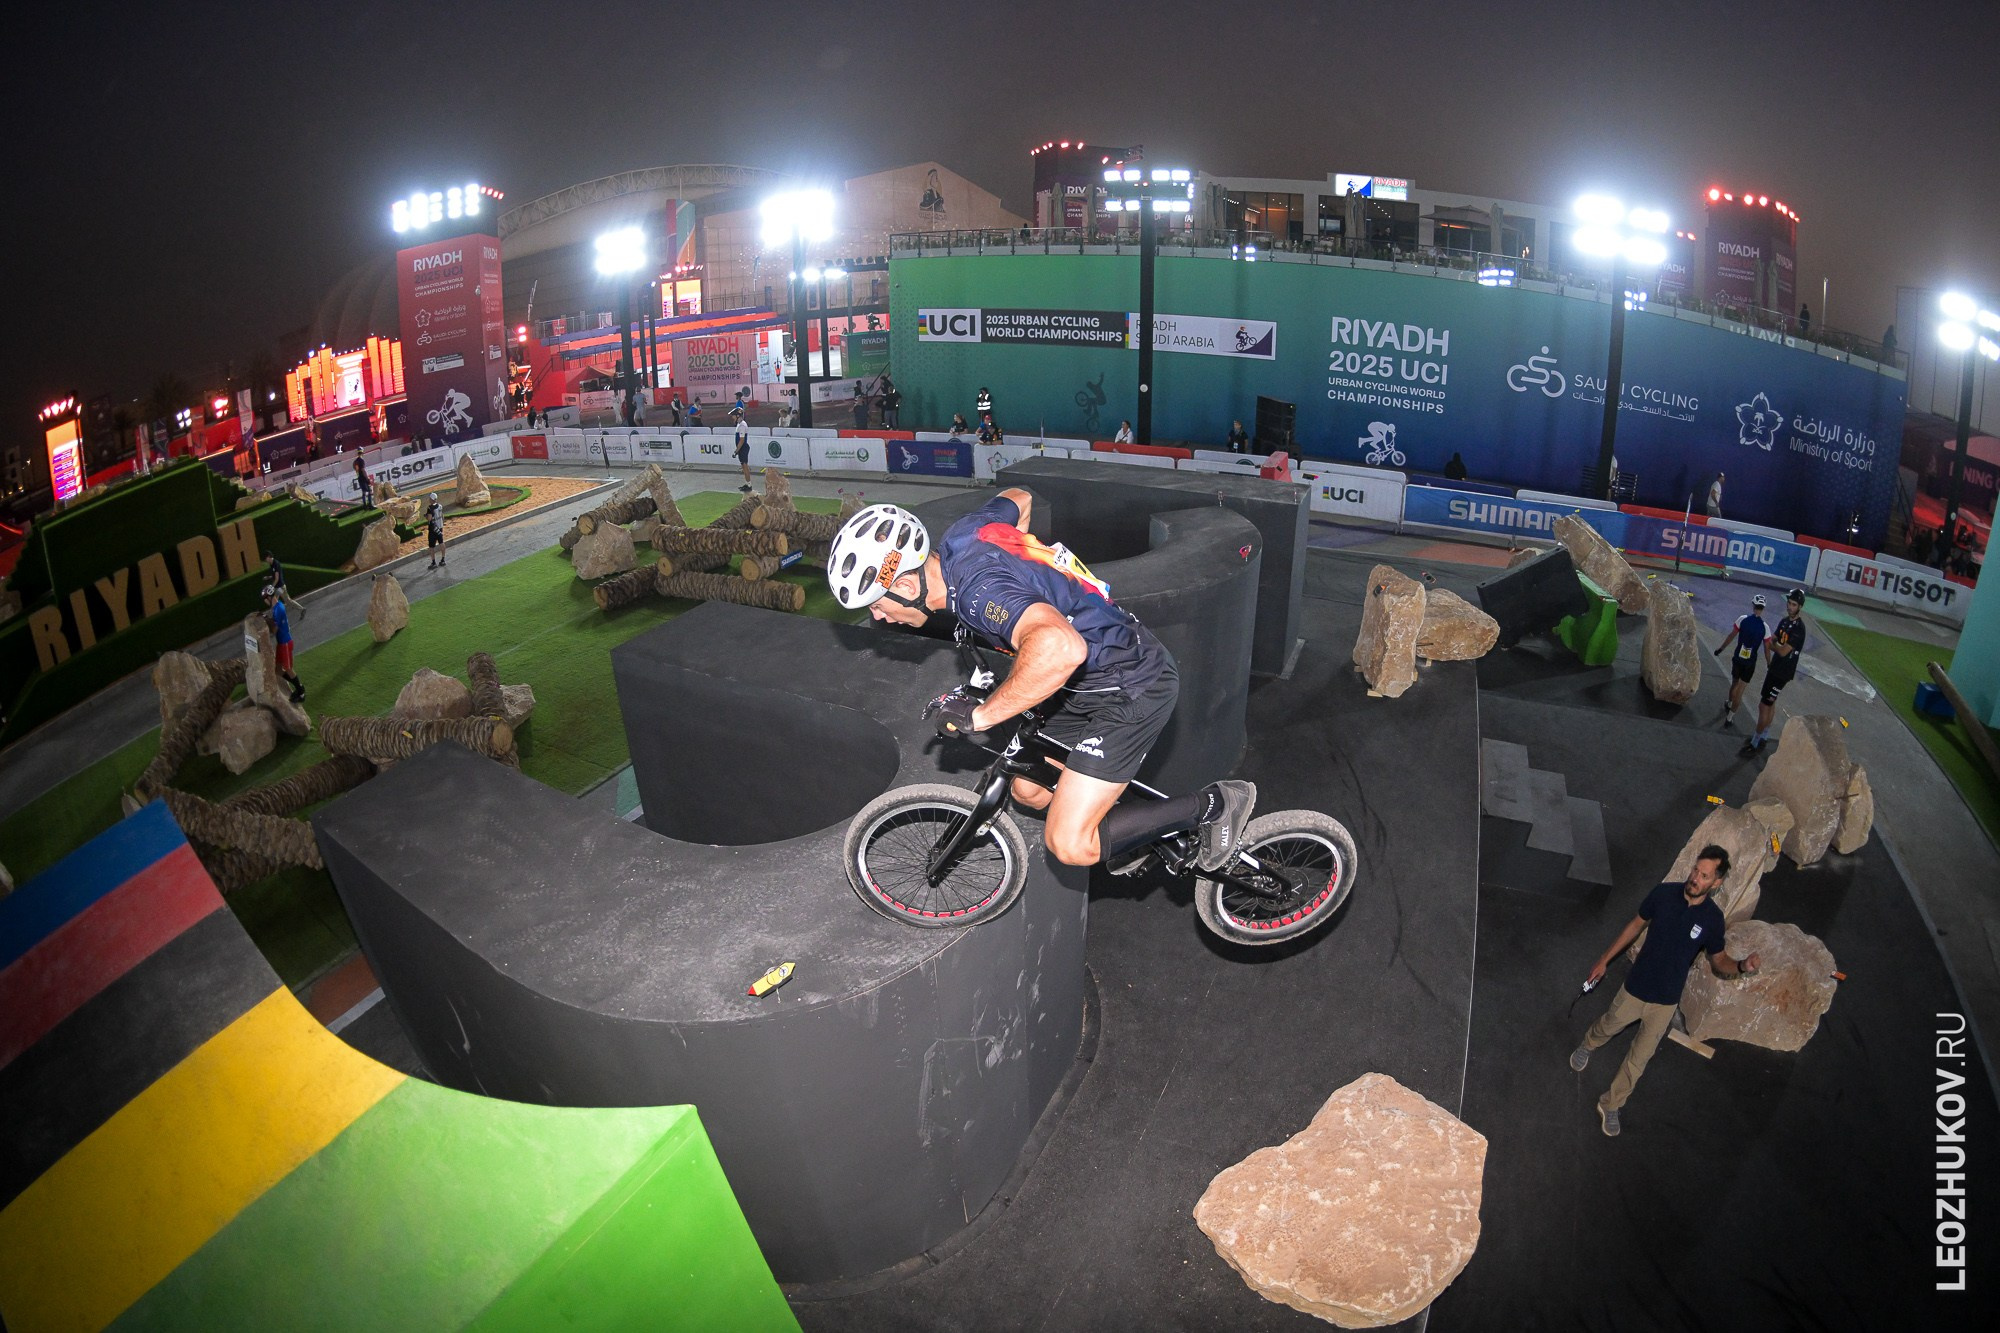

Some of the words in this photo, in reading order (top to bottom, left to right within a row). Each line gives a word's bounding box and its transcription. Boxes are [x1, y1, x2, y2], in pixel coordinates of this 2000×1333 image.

[413, 250, 462, 272] RIYADH
[1718, 242, 1760, 258] RIYADH
[415, 283, 464, 297] CHAMPIONSHIPS
[928, 314, 976, 336] UCI
[986, 315, 1009, 325] 2025
[1011, 315, 1049, 326] URBAN
[1051, 316, 1100, 328] CYCLING
[1136, 319, 1177, 332] RADH
[687, 336, 739, 355] RIYADH
[861, 337, 887, 345] RIYADH
[986, 327, 1025, 338] WORLD
[1027, 328, 1122, 342] CHAMPIONSHIPS
[1136, 333, 1170, 345] SUDI
[1172, 336, 1215, 348] ARABIA
[1331, 316, 1449, 357] RIYADH
[688, 354, 716, 368] 2025
[718, 353, 740, 366] UCI
[1329, 350, 1393, 378] 2025
[1401, 358, 1448, 385] UCI
[688, 373, 740, 381] CHAMPIONSHIPS
[1328, 377, 1363, 388] URBAN
[1364, 381, 1408, 394] CYCLING
[1409, 387, 1446, 399] WORLD
[1327, 389, 1444, 414] CHAMPIONSHIPS
[1574, 374, 1625, 395] SAUI
[1631, 385, 1699, 411] CYCLING
[1793, 414, 1841, 443] الرياضة
[705, 444, 722, 454] UCI
[1844, 428, 1875, 456] وزارة
[1789, 436, 1830, 462] Ministry
[1831, 450, 1844, 463] of
[1844, 451, 1873, 472] Sport
[376, 456, 436, 482] TISSOT
[1330, 486, 1364, 503] UCI
[1449, 499, 1562, 531] SHIMAN
[1661, 528, 1775, 565] SHIMANO
[28, 517, 262, 673] RIYADH
[1881, 570, 1955, 606] TISSOT
[985, 601, 1009, 625] ESP
